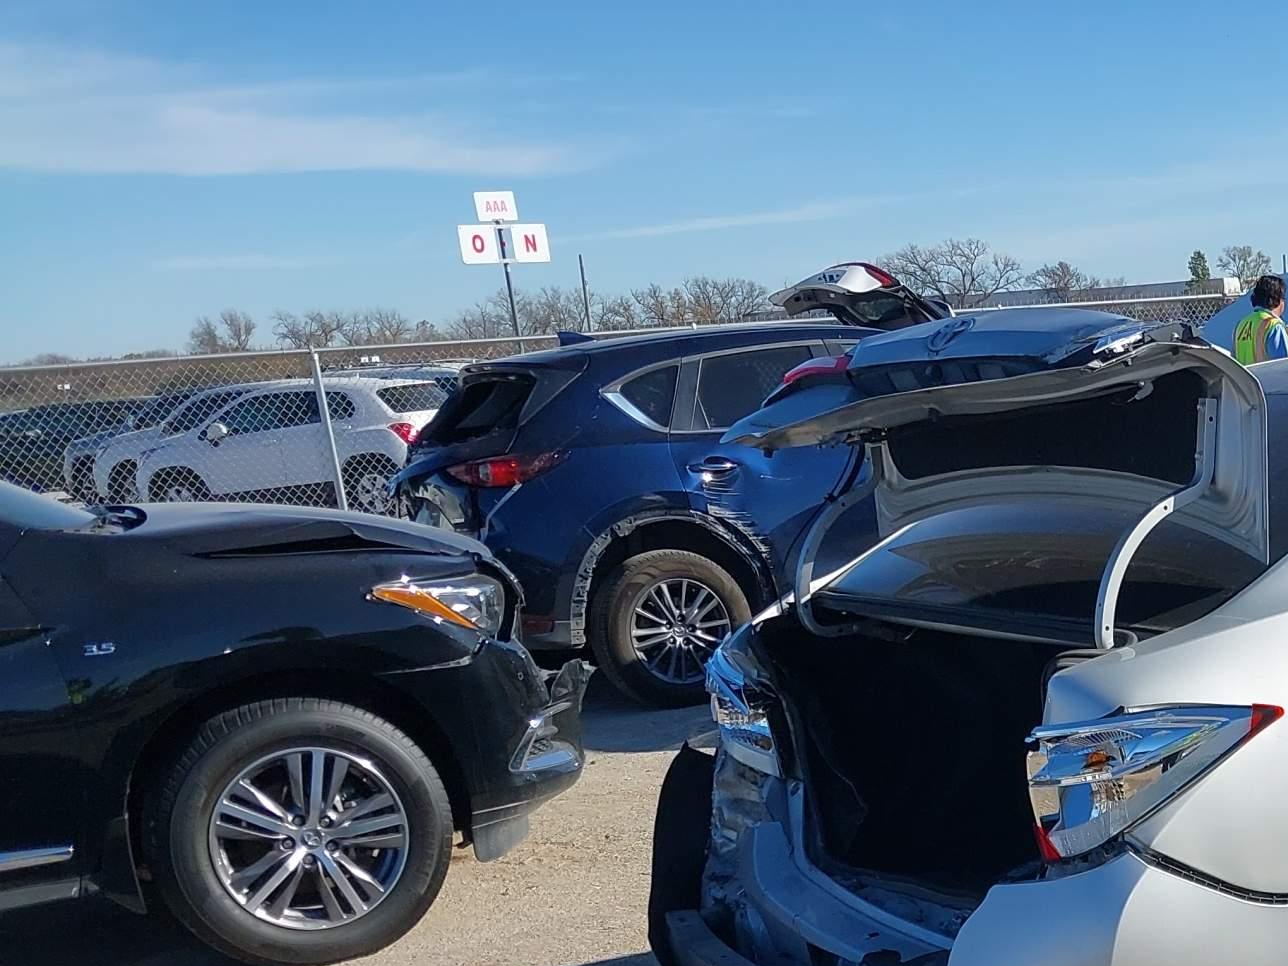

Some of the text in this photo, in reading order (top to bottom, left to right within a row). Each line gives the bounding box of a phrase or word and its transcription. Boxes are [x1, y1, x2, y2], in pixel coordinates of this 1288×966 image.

[485, 200, 508, 213] AAA
[471, 234, 485, 253] O
[523, 234, 538, 253] N
